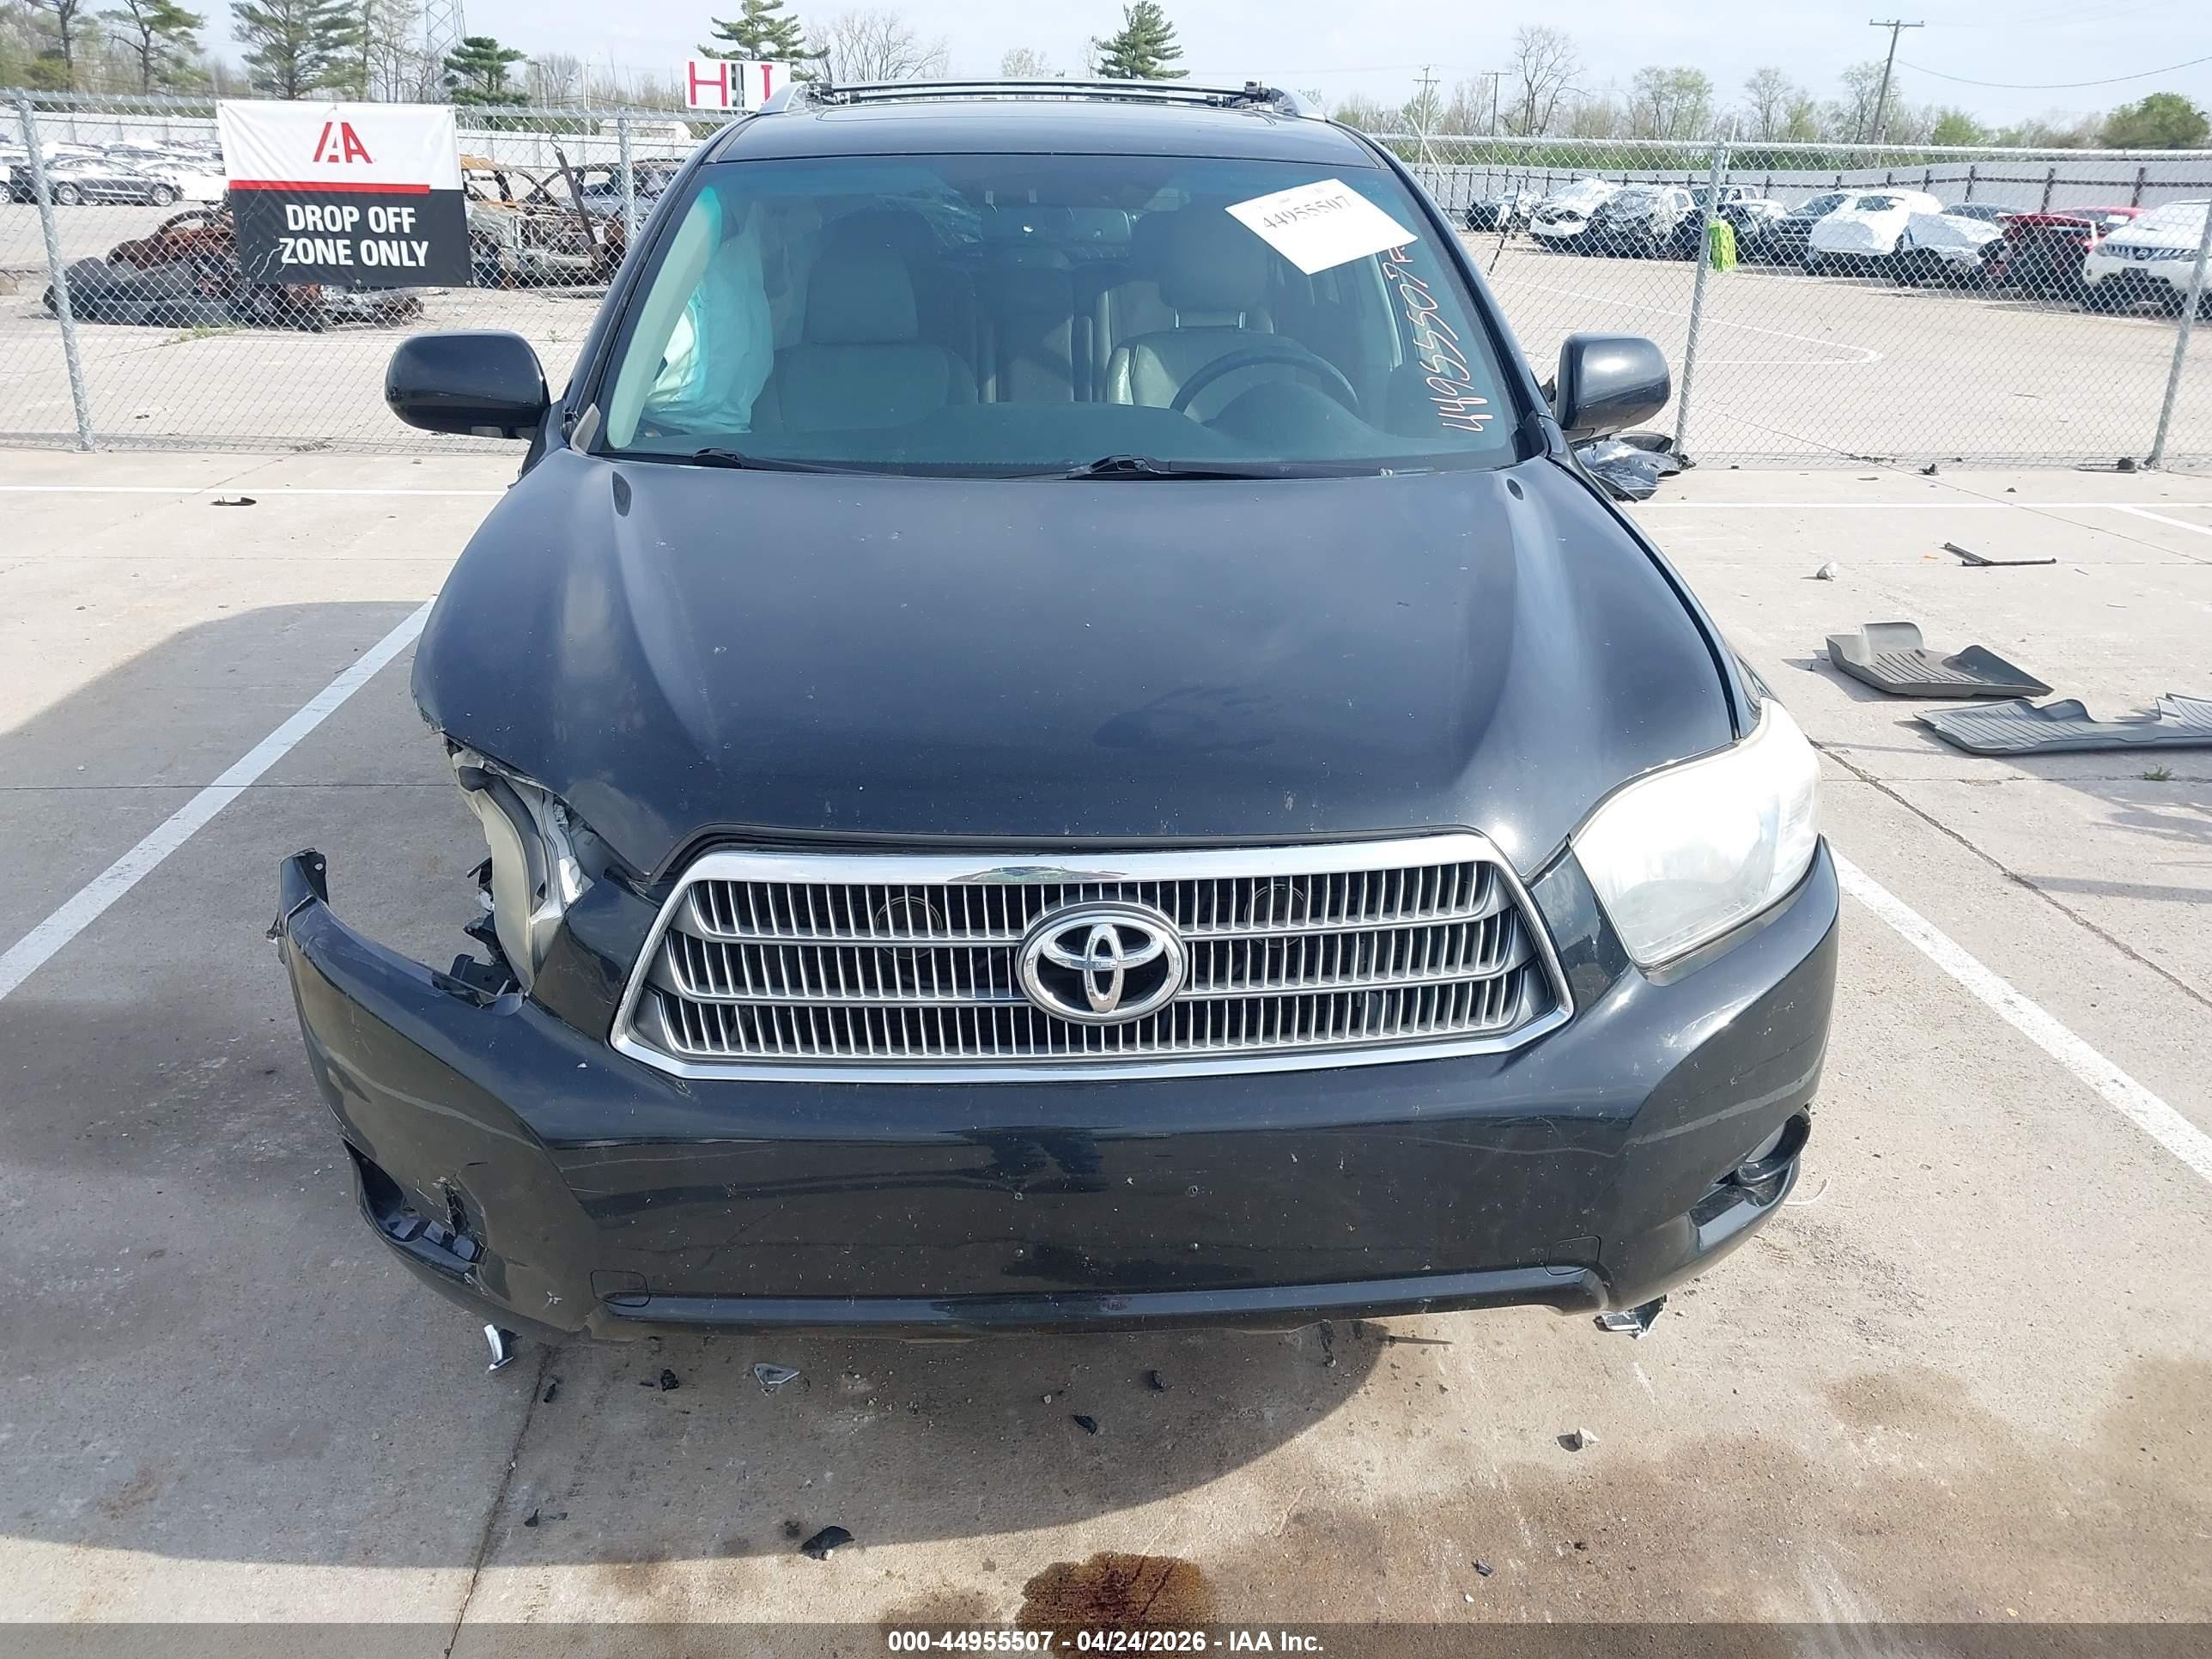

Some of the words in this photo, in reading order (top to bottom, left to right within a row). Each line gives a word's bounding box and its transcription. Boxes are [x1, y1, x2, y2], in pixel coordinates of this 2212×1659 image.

[689, 61, 727, 106] H
[286, 204, 360, 233] DROP
[368, 206, 416, 234] OFF
[1263, 195, 1352, 228] 44955507
[280, 237, 354, 266] ZONE
[360, 239, 428, 267] ONLY
